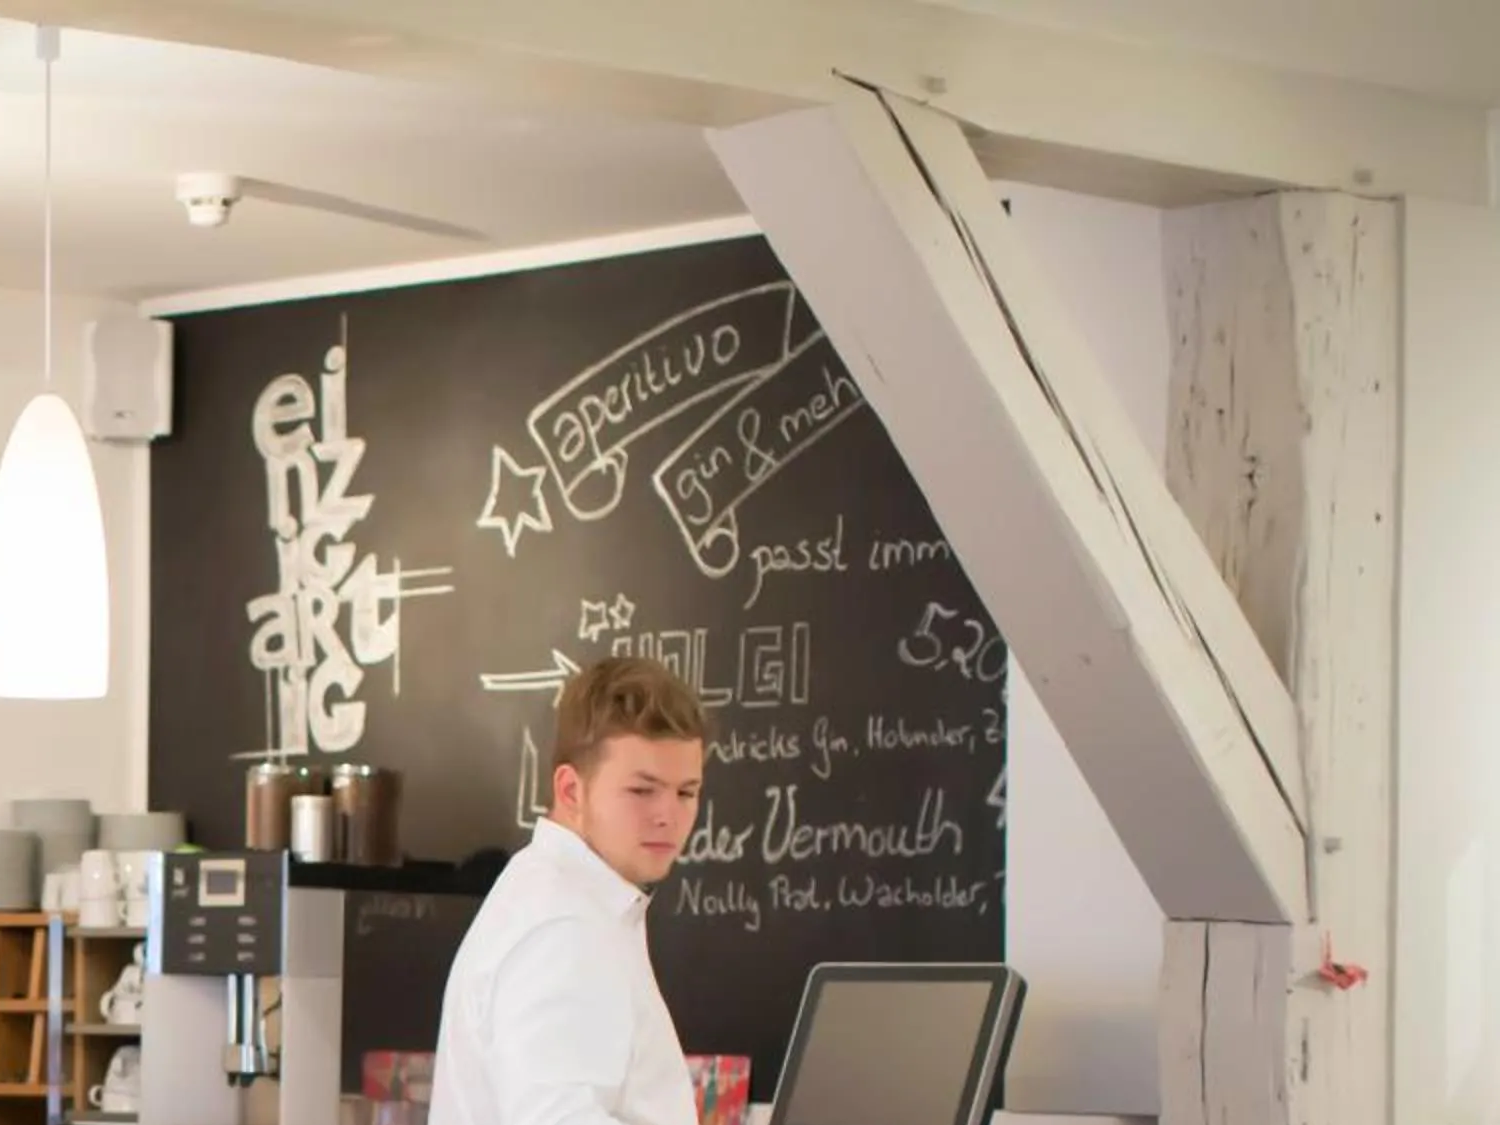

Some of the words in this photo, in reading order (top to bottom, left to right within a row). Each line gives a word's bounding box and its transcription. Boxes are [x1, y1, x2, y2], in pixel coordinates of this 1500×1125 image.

[553, 324, 741, 470] aperitivo
[676, 445, 733, 524] gin
[737, 407, 780, 482] &
[780, 363, 860, 442] meh
[743, 514, 849, 610] passt
[868, 528, 950, 570] imm
[706, 726, 801, 764] ndricks
[762, 783, 963, 865] Vermouth
[838, 874, 987, 915] Wacholder,
